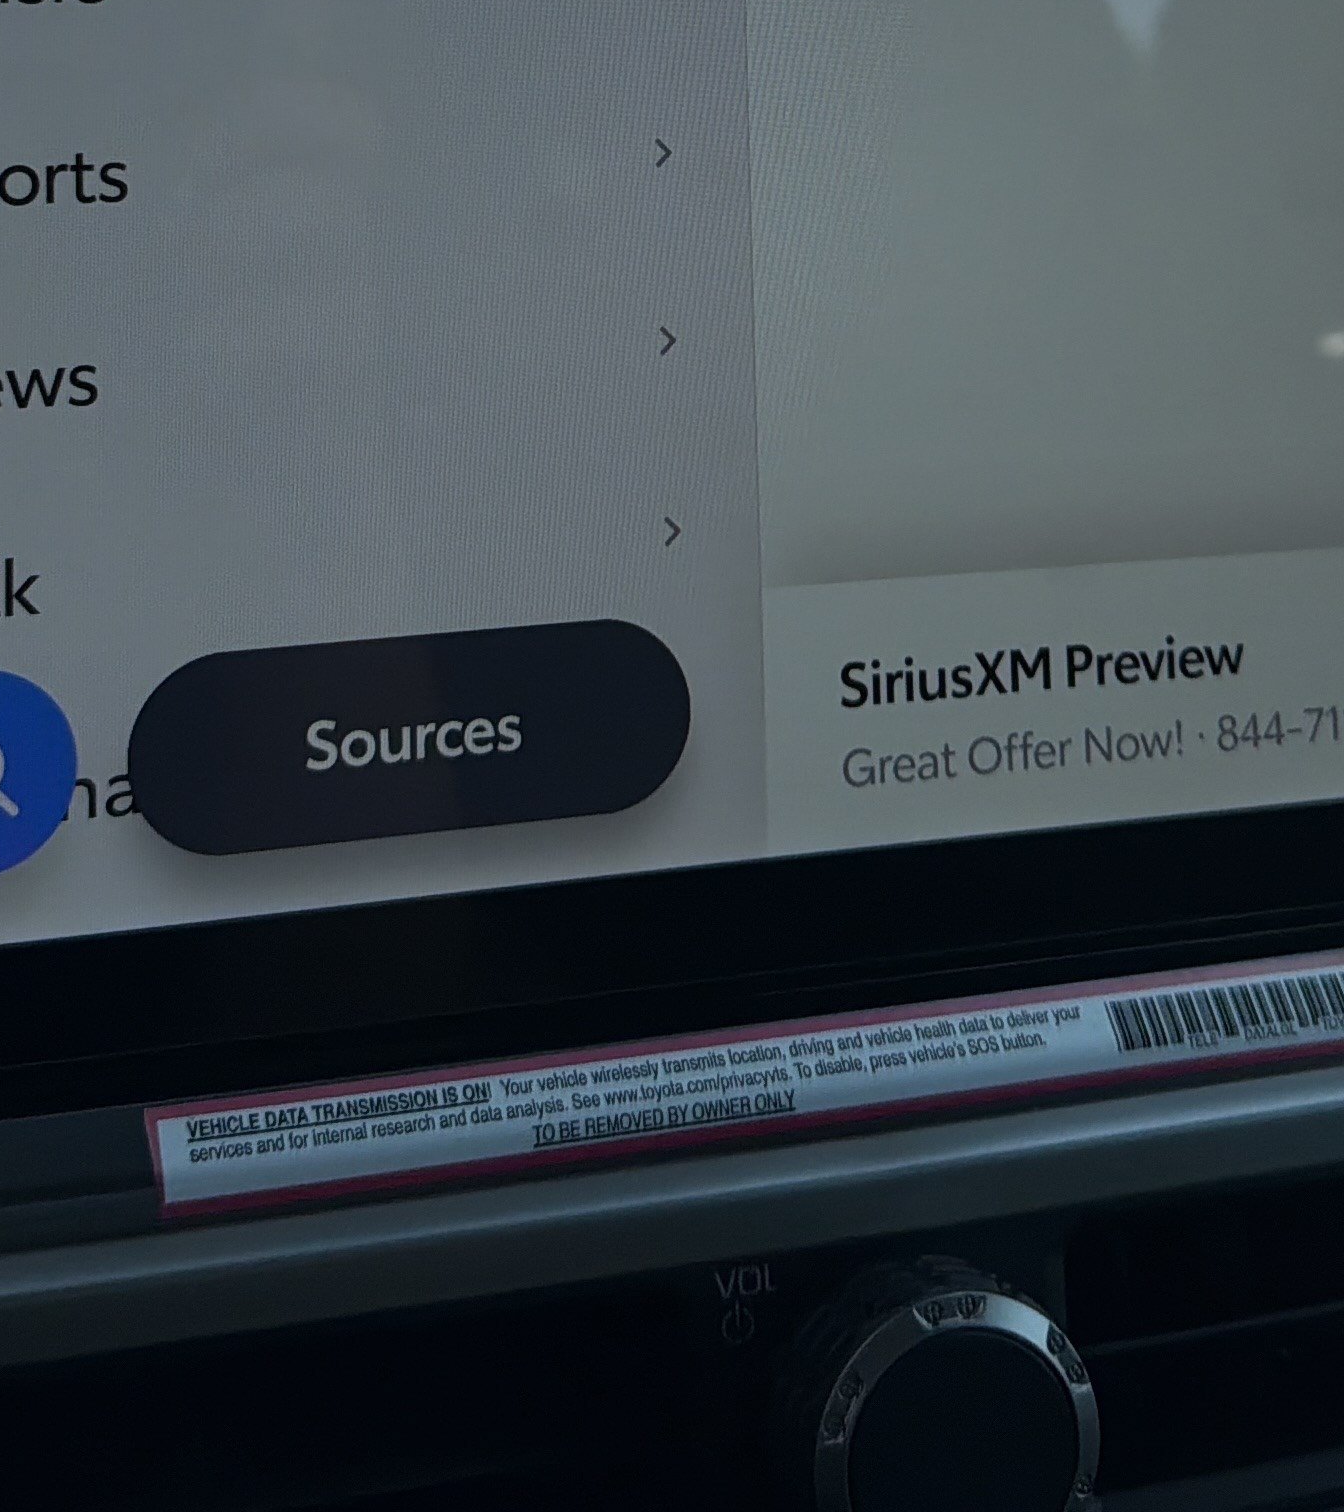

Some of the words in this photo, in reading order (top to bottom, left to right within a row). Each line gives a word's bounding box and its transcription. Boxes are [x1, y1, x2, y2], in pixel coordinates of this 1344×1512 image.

[838, 645, 1053, 711] SiriusXM
[1064, 636, 1247, 690] Preview
[303, 712, 524, 773] Sources
[841, 745, 958, 790] Great
[967, 731, 1074, 779] Offer
[1083, 719, 1184, 766] Now!
[186, 1112, 261, 1140] VEHICLE
[264, 1104, 309, 1131] DATA
[310, 1088, 439, 1124] TRANSMISSION
[441, 1086, 459, 1103] IS
[462, 1081, 492, 1102] ON!
[499, 1077, 534, 1098] Your
[536, 1068, 588, 1091] vehicle
[589, 1059, 660, 1086] wirelessly
[662, 1050, 727, 1074] transmits
[728, 1044, 788, 1067] location,
[788, 1037, 835, 1061] driving
[837, 1031, 863, 1052] and
[864, 1025, 912, 1048] vehicle
[914, 1018, 958, 1042] health
[959, 1014, 987, 1035] data
[988, 1012, 1005, 1030] to
[1006, 1007, 1051, 1029] deliver
[1051, 1004, 1082, 1027] your
[189, 1140, 253, 1164] services
[256, 1131, 285, 1155] and
[289, 1127, 310, 1150] for
[312, 1119, 368, 1146] internal
[371, 1111, 436, 1138] research
[439, 1106, 467, 1129] and
[470, 1101, 503, 1124] data
[506, 1092, 570, 1120] analysis.
[571, 1088, 601, 1109] See
[792, 1060, 813, 1080] To
[814, 1051, 869, 1077] disable,
[869, 1047, 908, 1074] press
[908, 1040, 967, 1063] vehicle's
[968, 1033, 1001, 1056] SOS
[1001, 1029, 1047, 1051] button.
[532, 1121, 557, 1145] TO
[559, 1118, 582, 1141] BE
[584, 1106, 664, 1138] REMOVED
[667, 1102, 690, 1126] BY
[692, 1094, 752, 1122] OWNER
[753, 1088, 796, 1112] ONLY
[713, 1262, 775, 1301] VOL
